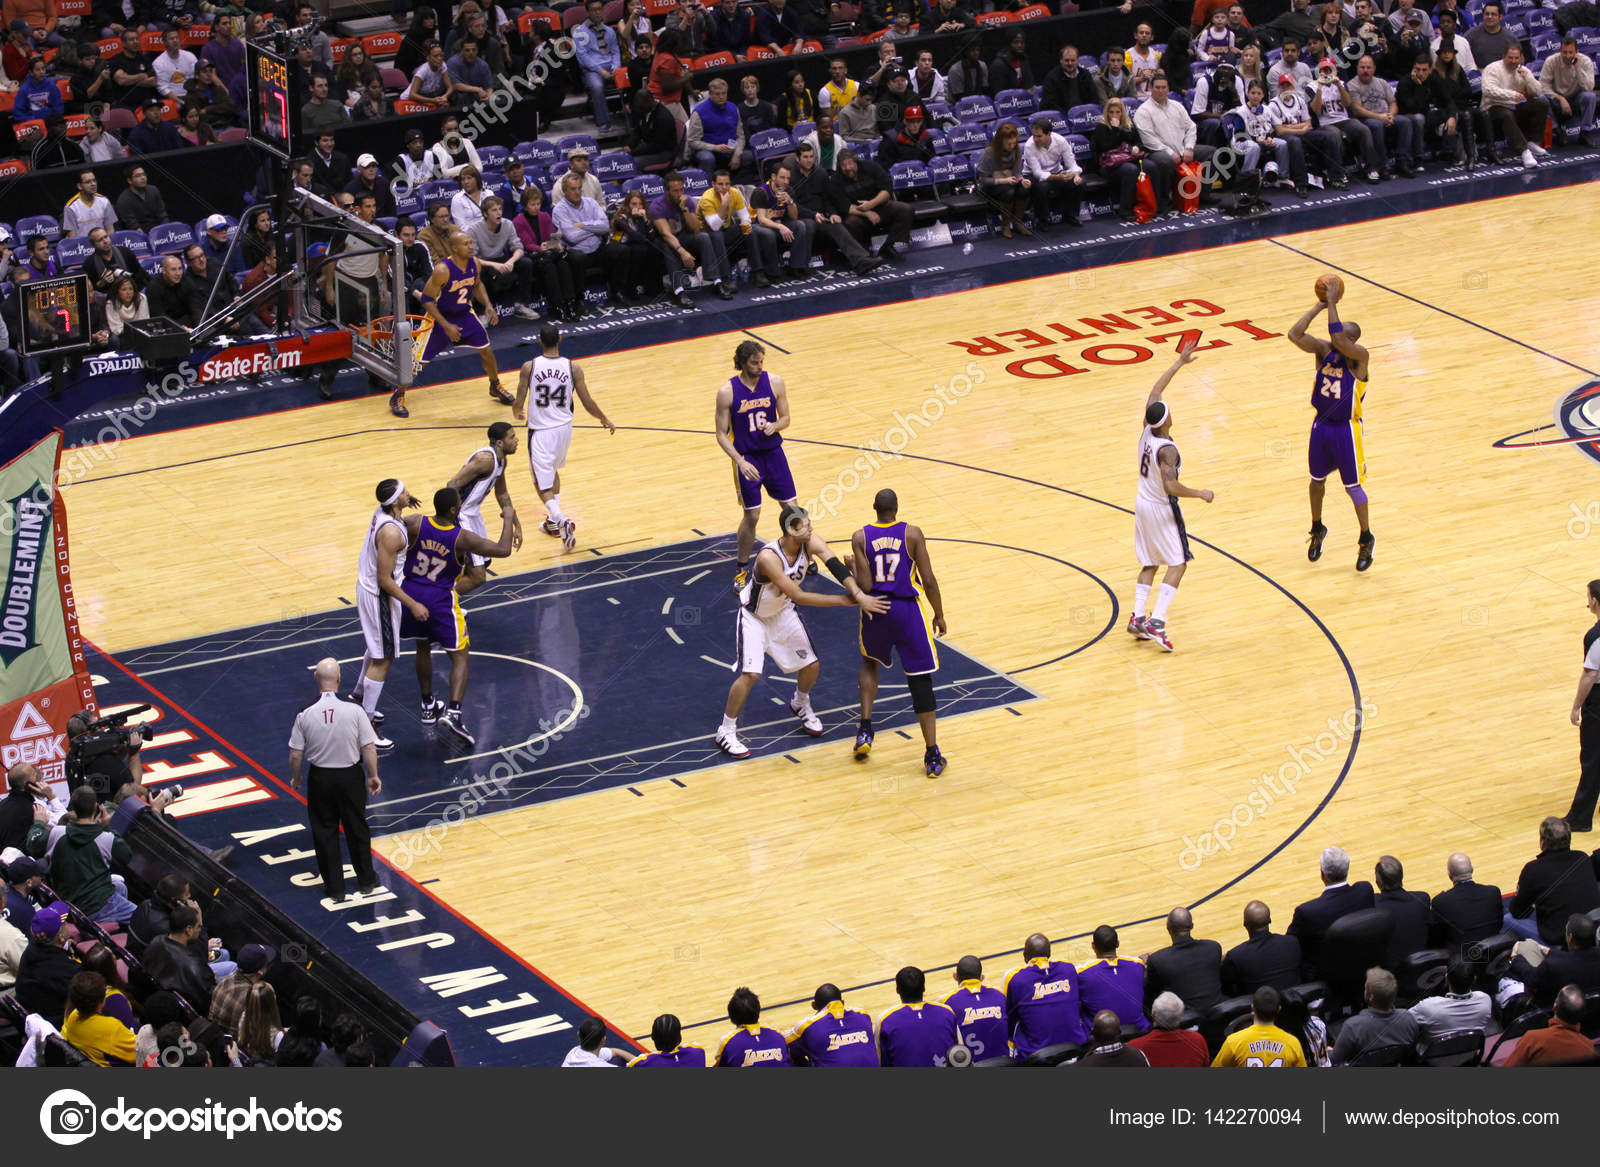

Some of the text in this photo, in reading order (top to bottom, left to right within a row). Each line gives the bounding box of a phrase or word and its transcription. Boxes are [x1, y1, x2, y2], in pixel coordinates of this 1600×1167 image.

[61, 1, 85, 9] IZOD
[1020, 9, 1042, 20] IZOD
[100, 43, 118, 53] ZOD
[332, 45, 346, 54] IZO
[372, 38, 395, 46] IZOD
[704, 57, 726, 68] IZOD
[757, 51, 776, 59] IZO
[66, 119, 85, 129] ZOD
[755, 143, 768, 151] HIGH
[773, 137, 789, 146] POINT
[971, 134, 987, 142] POINT
[538, 150, 554, 158] POINT
[1074, 144, 1090, 153] POINT
[597, 163, 633, 173] HIGH POINT
[953, 164, 968, 172] POINT
[1427, 153, 1600, 185] www.highpint.com
[647, 185, 664, 193] POINT
[692, 179, 708, 188] POINT
[399, 197, 417, 205] POINT
[1304, 191, 1372, 207] Provider
[971, 224, 988, 232] POINT
[174, 232, 192, 241] POINT
[931, 233, 951, 241] POINT
[1005, 249, 1037, 257] The
[1041, 237, 1106, 251] Trusted
[1110, 223, 1179, 239] Network
[62, 249, 76, 257] HIGH
[129, 241, 147, 249] POINT
[751, 264, 944, 302] www.highpoint.com
[34, 286, 77, 309] 10:28
[457, 288, 468, 304] 2
[56, 309, 71, 332] 7
[947, 299, 1226, 356] CENTER
[1005, 319, 1285, 379] IZOD
[90, 356, 151, 377] SPALDIN
[257, 380, 274, 388] IT
[534, 368, 569, 384] HARRIS
[535, 384, 567, 409] 34
[1320, 379, 1341, 399] 24
[737, 397, 771, 413] LAKERS
[748, 411, 767, 432] 16
[1140, 454, 1149, 477] 6
[0, 497, 50, 649] DOUBLEMINT
[412, 552, 447, 582] 37
[874, 554, 900, 582] 17
[79, 679, 95, 714] .CO
[322, 708, 335, 724] 17
[1, 733, 66, 770] PEAK
[1032, 979, 1071, 1000] LAKERS
[419, 966, 573, 1043] NEW
[962, 1006, 1002, 1026] LAKERS
[828, 1031, 869, 1051] LAKERS
[1248, 1040, 1286, 1056] BRYANT
[742, 1048, 783, 1067] LAKERS
